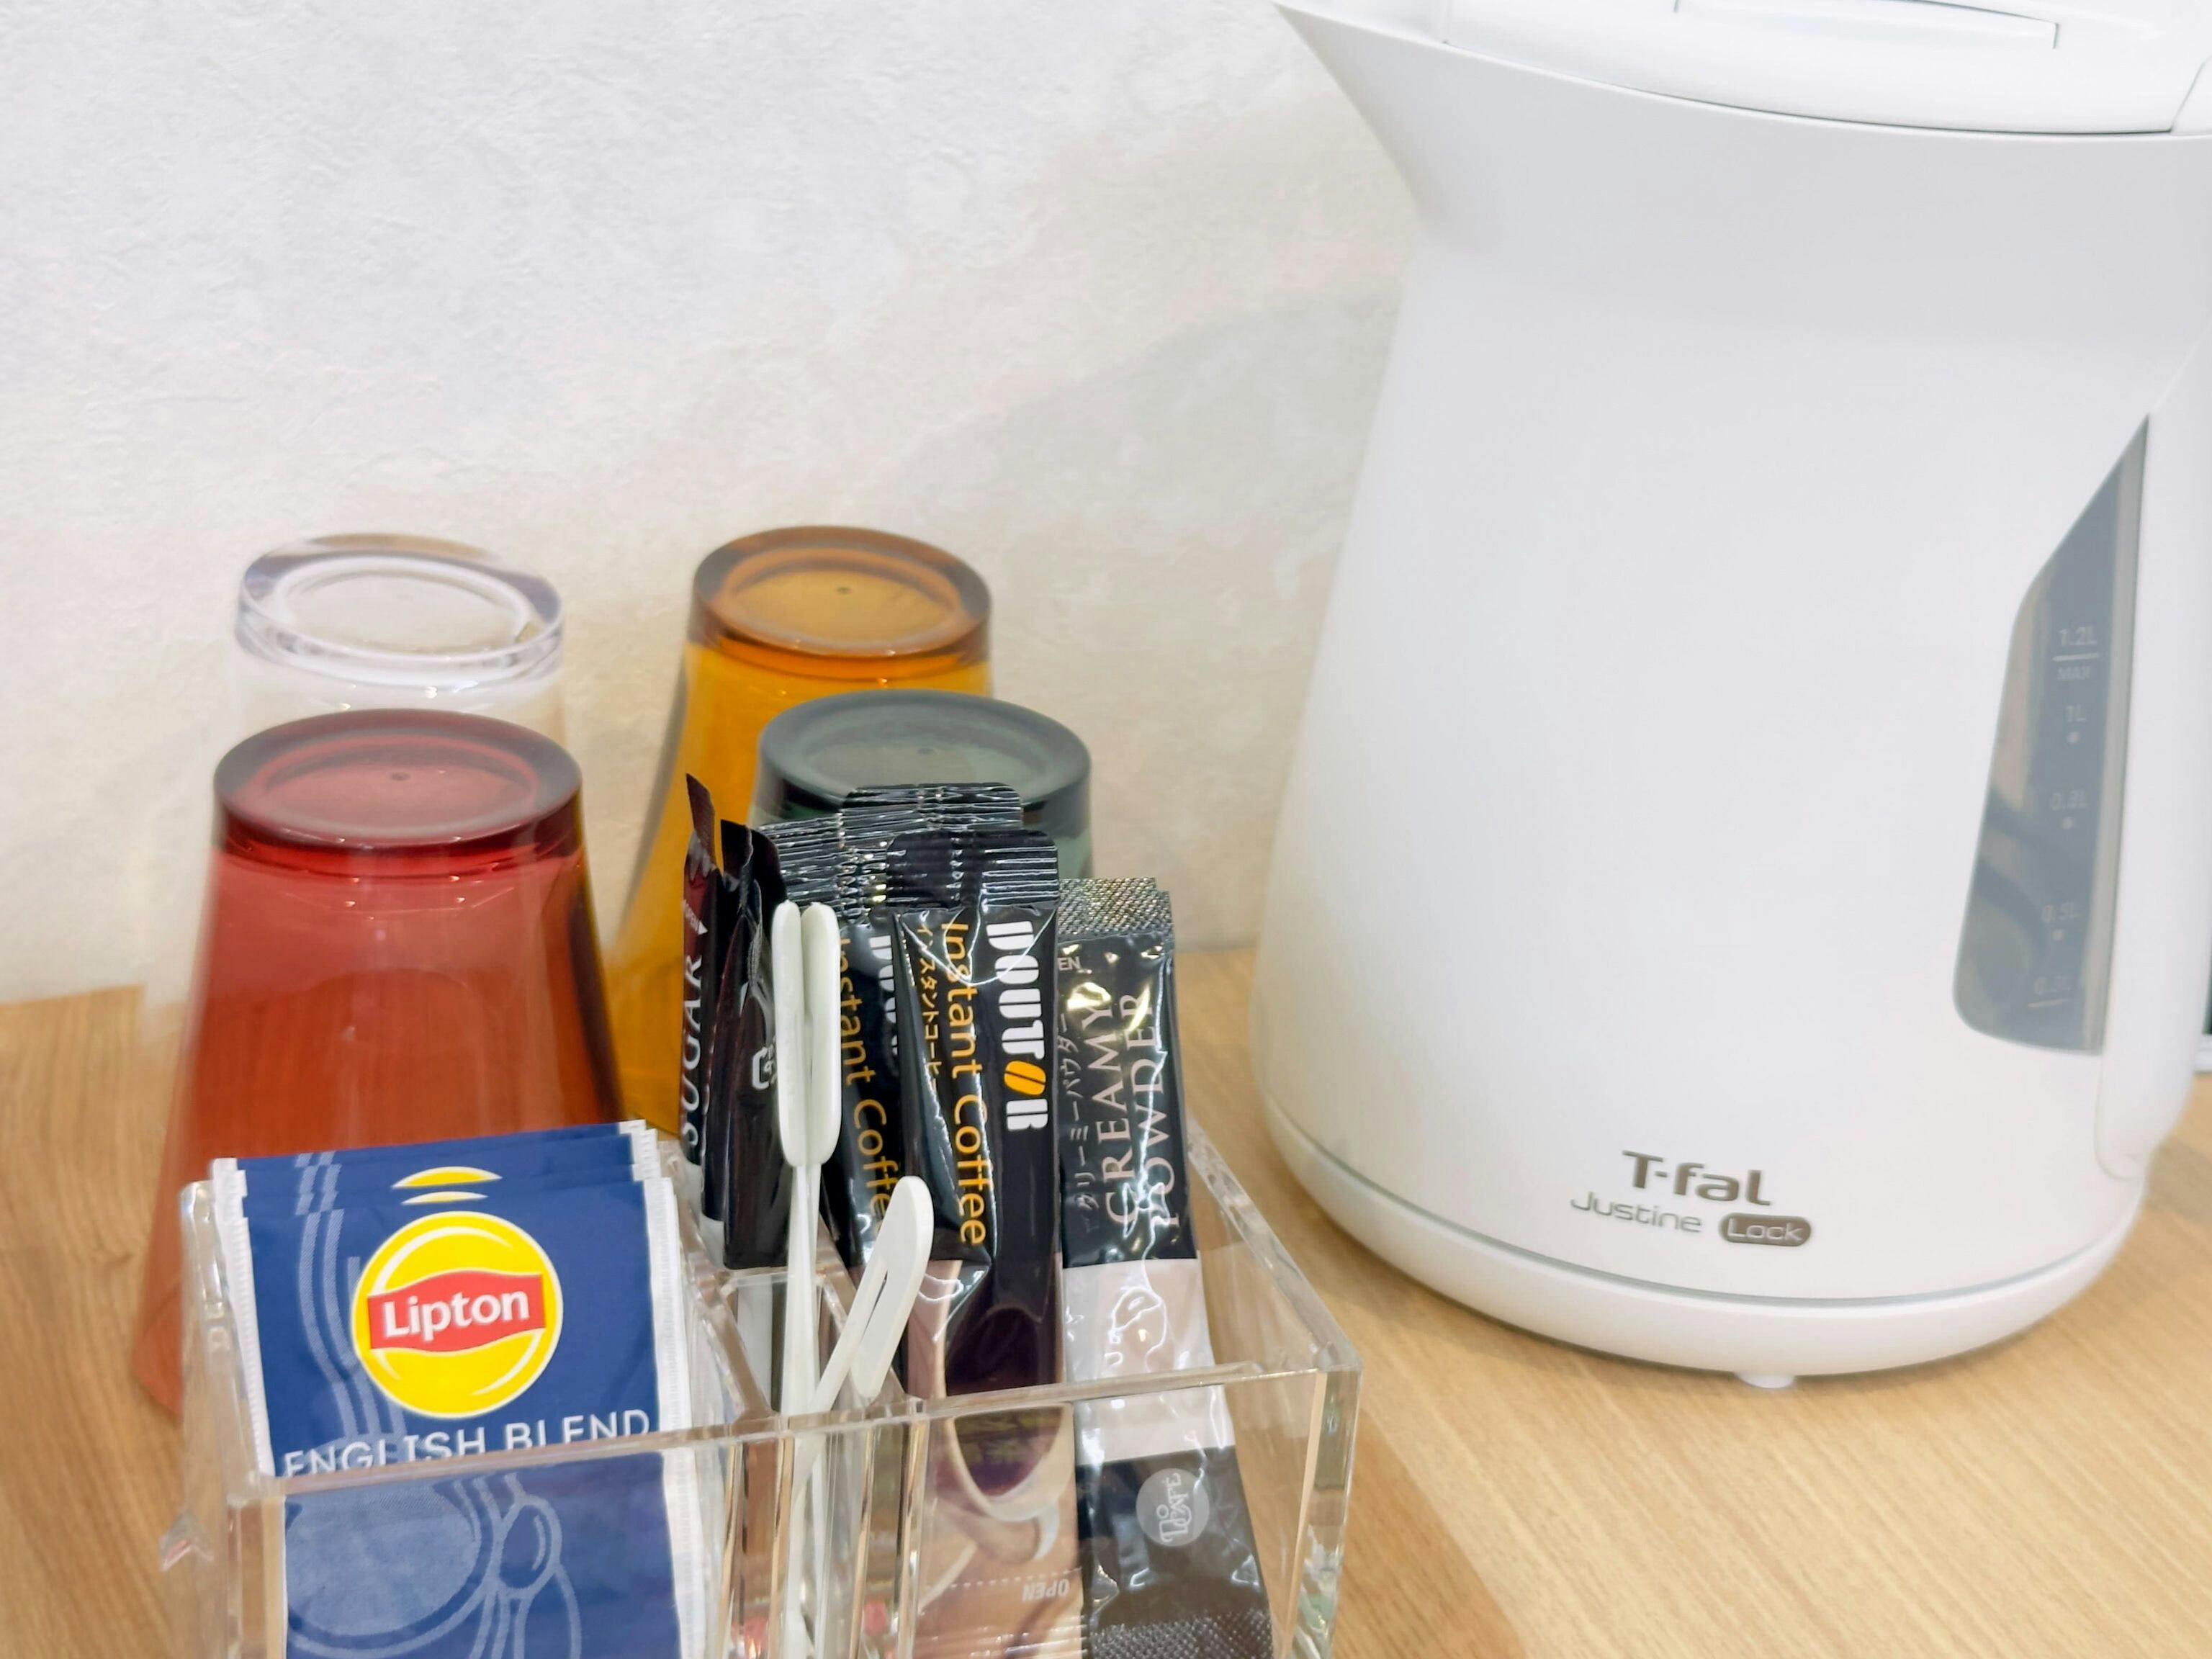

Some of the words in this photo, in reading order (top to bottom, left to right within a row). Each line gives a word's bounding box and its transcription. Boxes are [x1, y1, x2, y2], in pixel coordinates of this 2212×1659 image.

[840, 936, 876, 1087] stant
[941, 921, 982, 1079] Instant
[853, 1099, 899, 1230] Coffe
[1082, 1005, 1138, 1226] CREAMY
[953, 1094, 994, 1246] Coffee
[1570, 1191, 1702, 1233] Justine
[1727, 1216, 1802, 1242] Lock
[1621, 1150, 1773, 1206] T-fal
[383, 1290, 530, 1342] Lipton
[284, 1426, 486, 1477] ENGLISH
[506, 1408, 650, 1450] BLEND
[1022, 1578, 1071, 1602] OPEN
